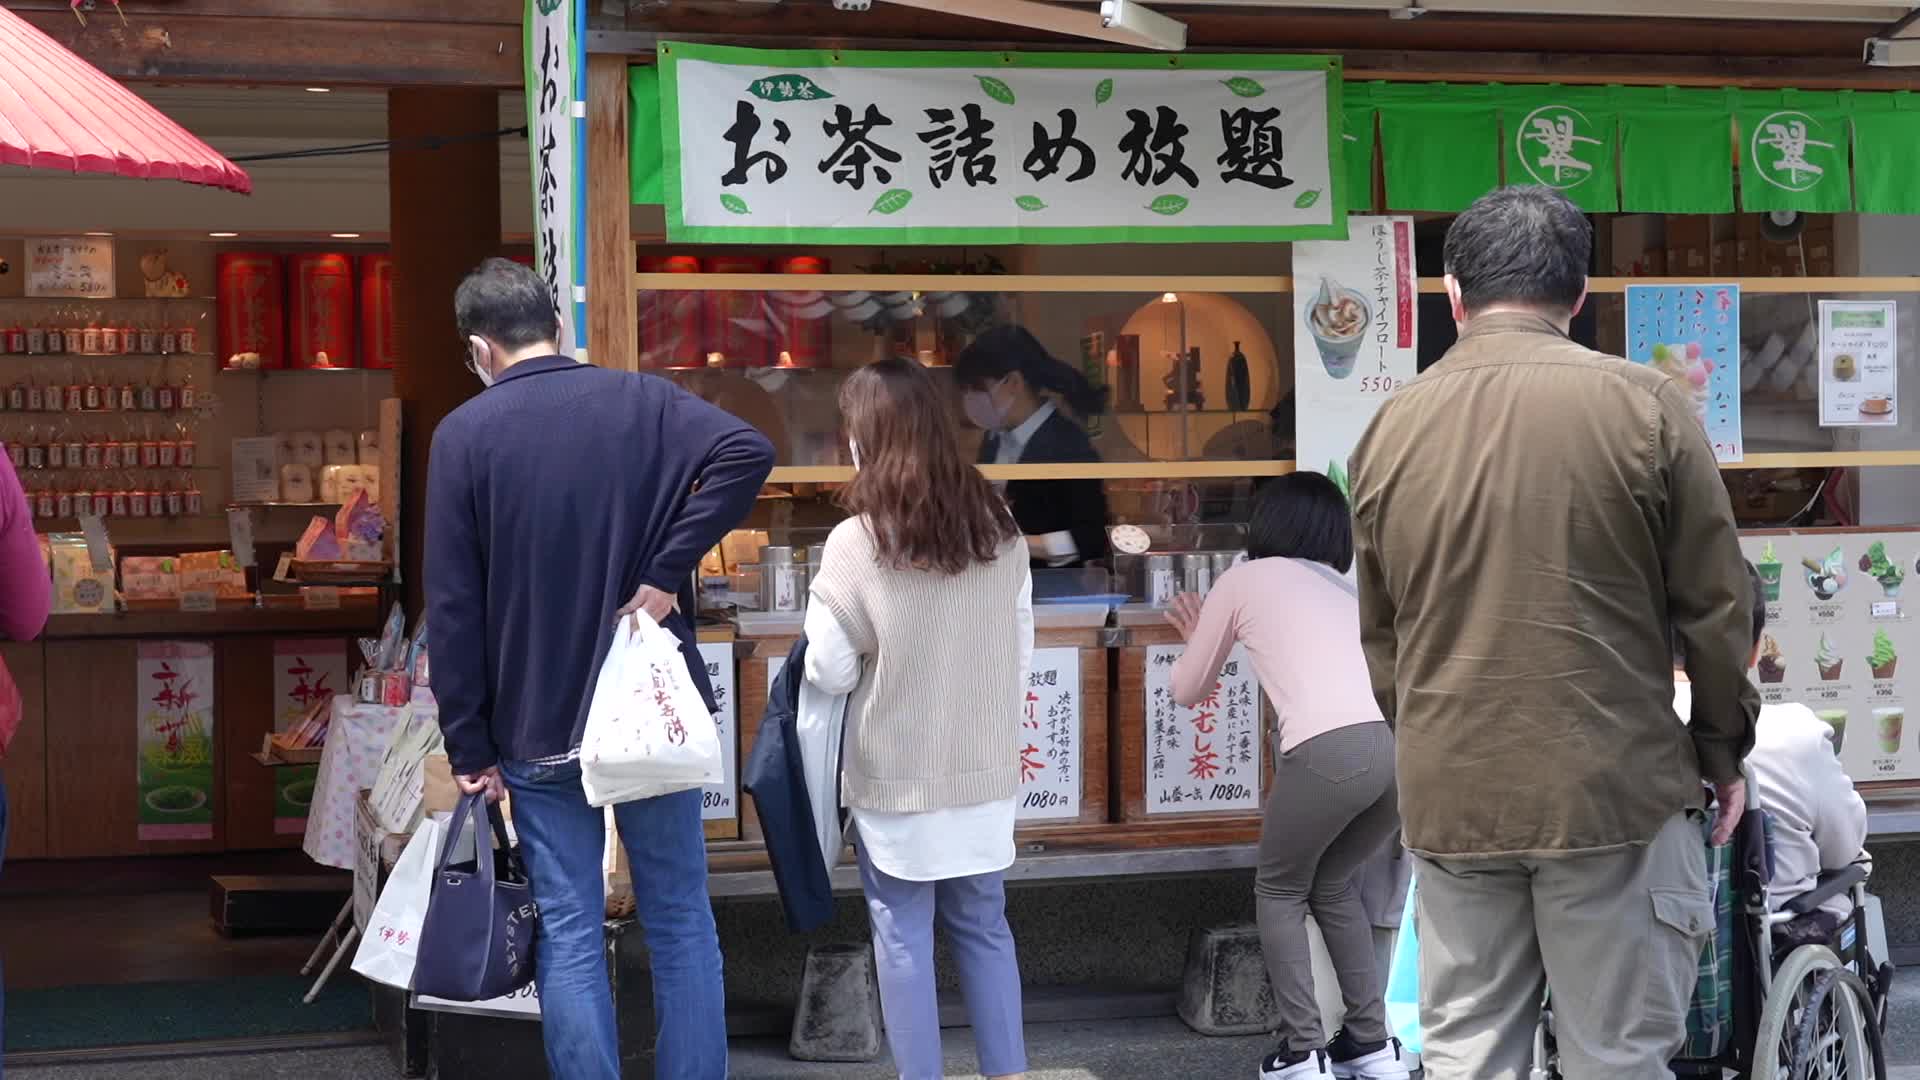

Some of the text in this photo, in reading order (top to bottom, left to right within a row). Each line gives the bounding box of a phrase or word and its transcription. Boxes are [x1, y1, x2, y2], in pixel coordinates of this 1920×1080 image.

[760, 81, 815, 98] 伊勢茶
[721, 100, 1296, 188] お茶詰め放題
[1371, 225, 1393, 373] ほうじ茶チャイフロート
[1047, 705, 1059, 760] おすすめ
[1058, 691, 1072, 783] 渋みがお好みの方に
[1225, 687, 1239, 775] お土産におすすめ
[1240, 681, 1252, 763] 美味しい一番茶
[1023, 790, 1069, 808] 1080円
[1209, 783, 1251, 801] 1080円
